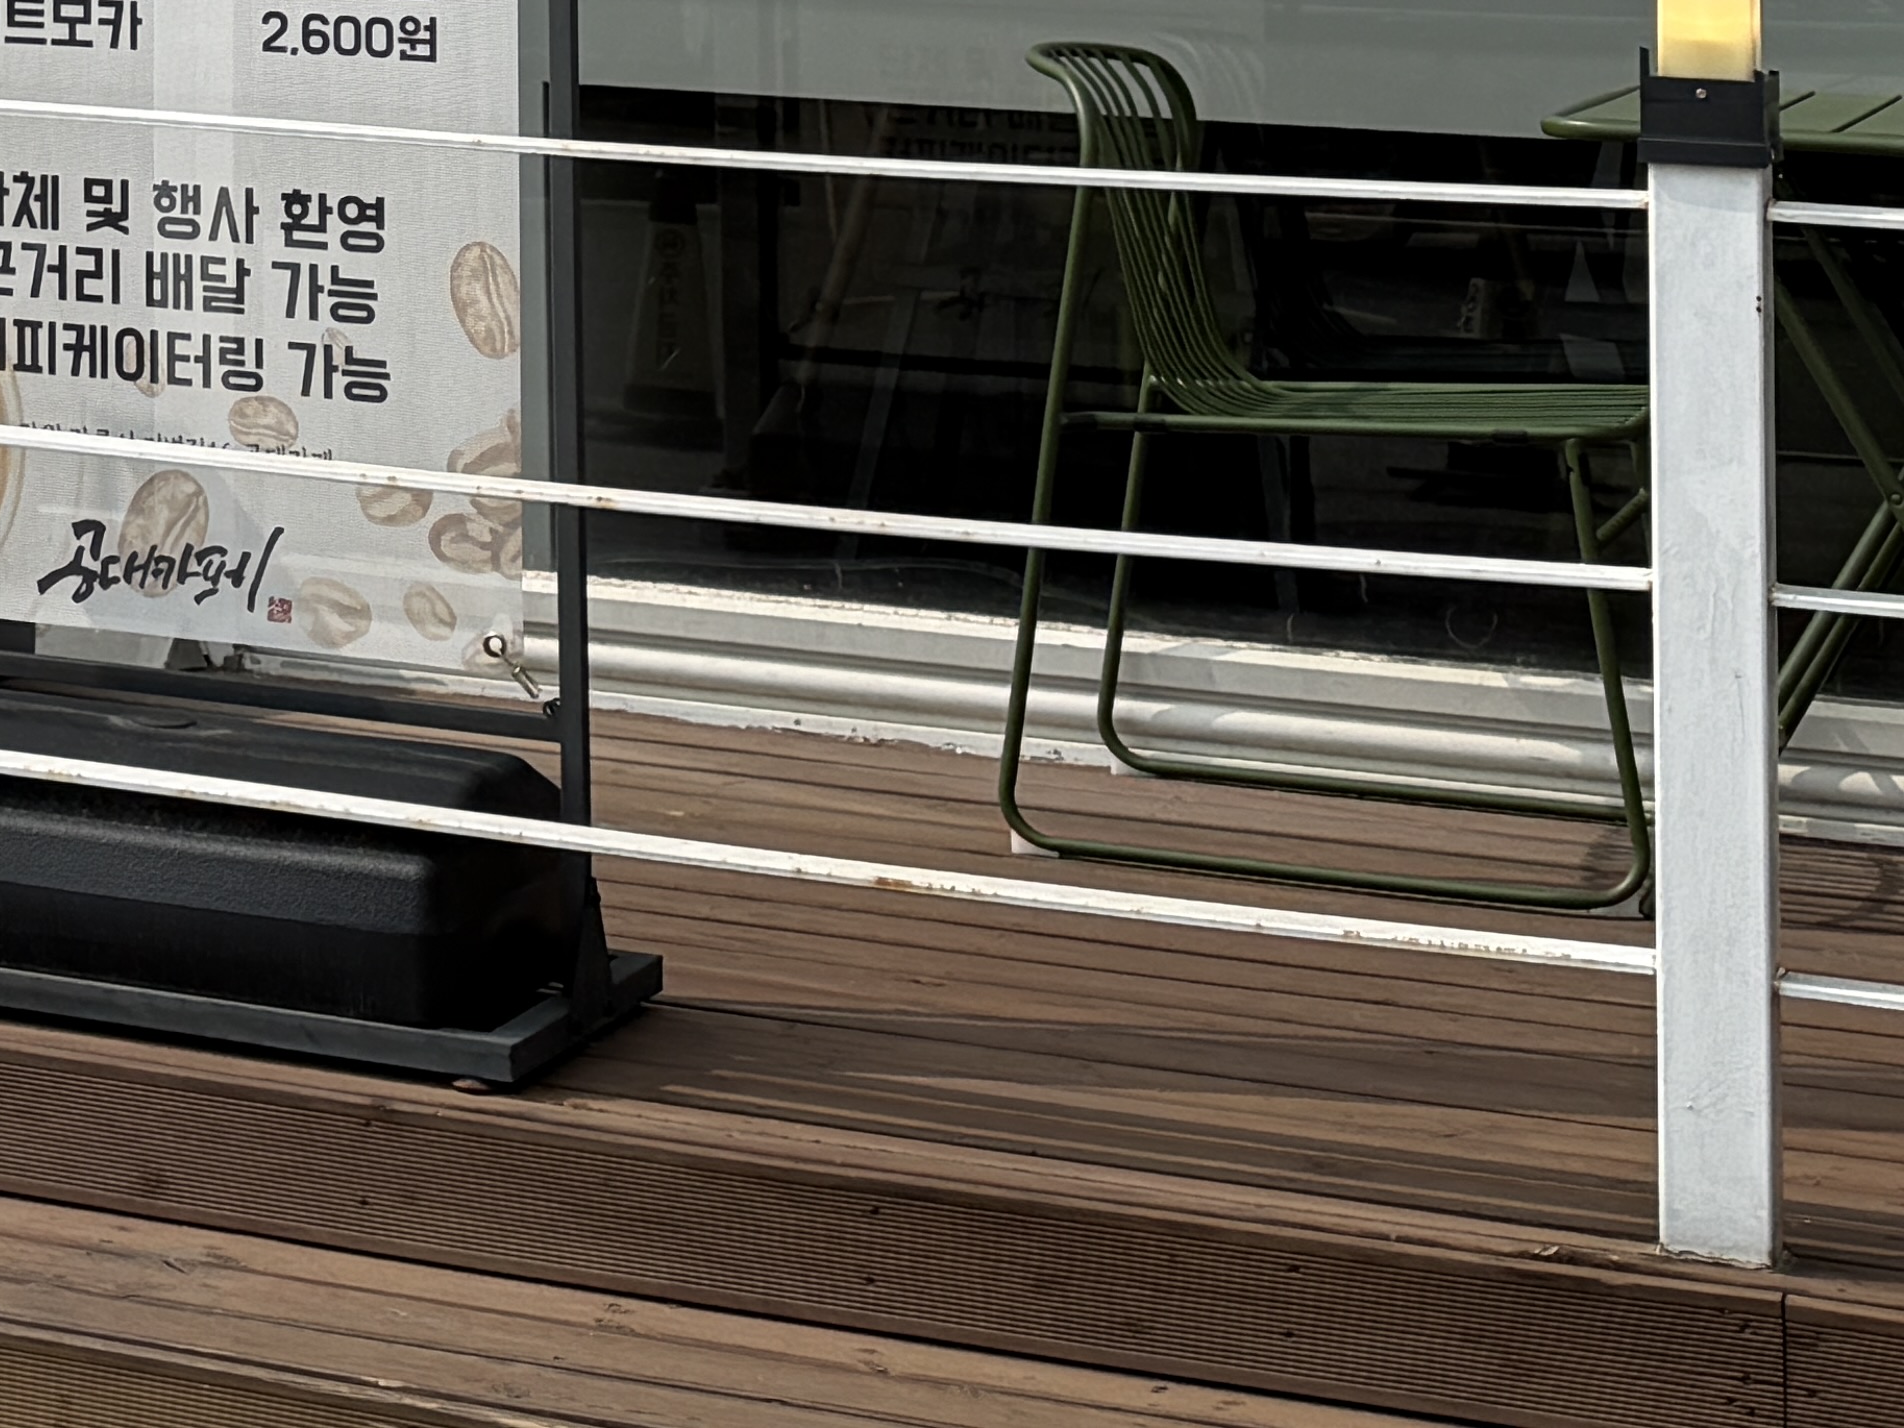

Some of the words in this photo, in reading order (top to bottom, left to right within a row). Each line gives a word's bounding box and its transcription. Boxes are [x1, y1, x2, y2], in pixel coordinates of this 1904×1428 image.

[83, 177, 130, 235] 및
[152, 179, 260, 245] 행사
[280, 188, 385, 254] 환영
[145, 250, 252, 315] 배달
[271, 260, 379, 325] 가능
[287, 341, 391, 404] 가능
[36, 518, 285, 614] 공대카페
